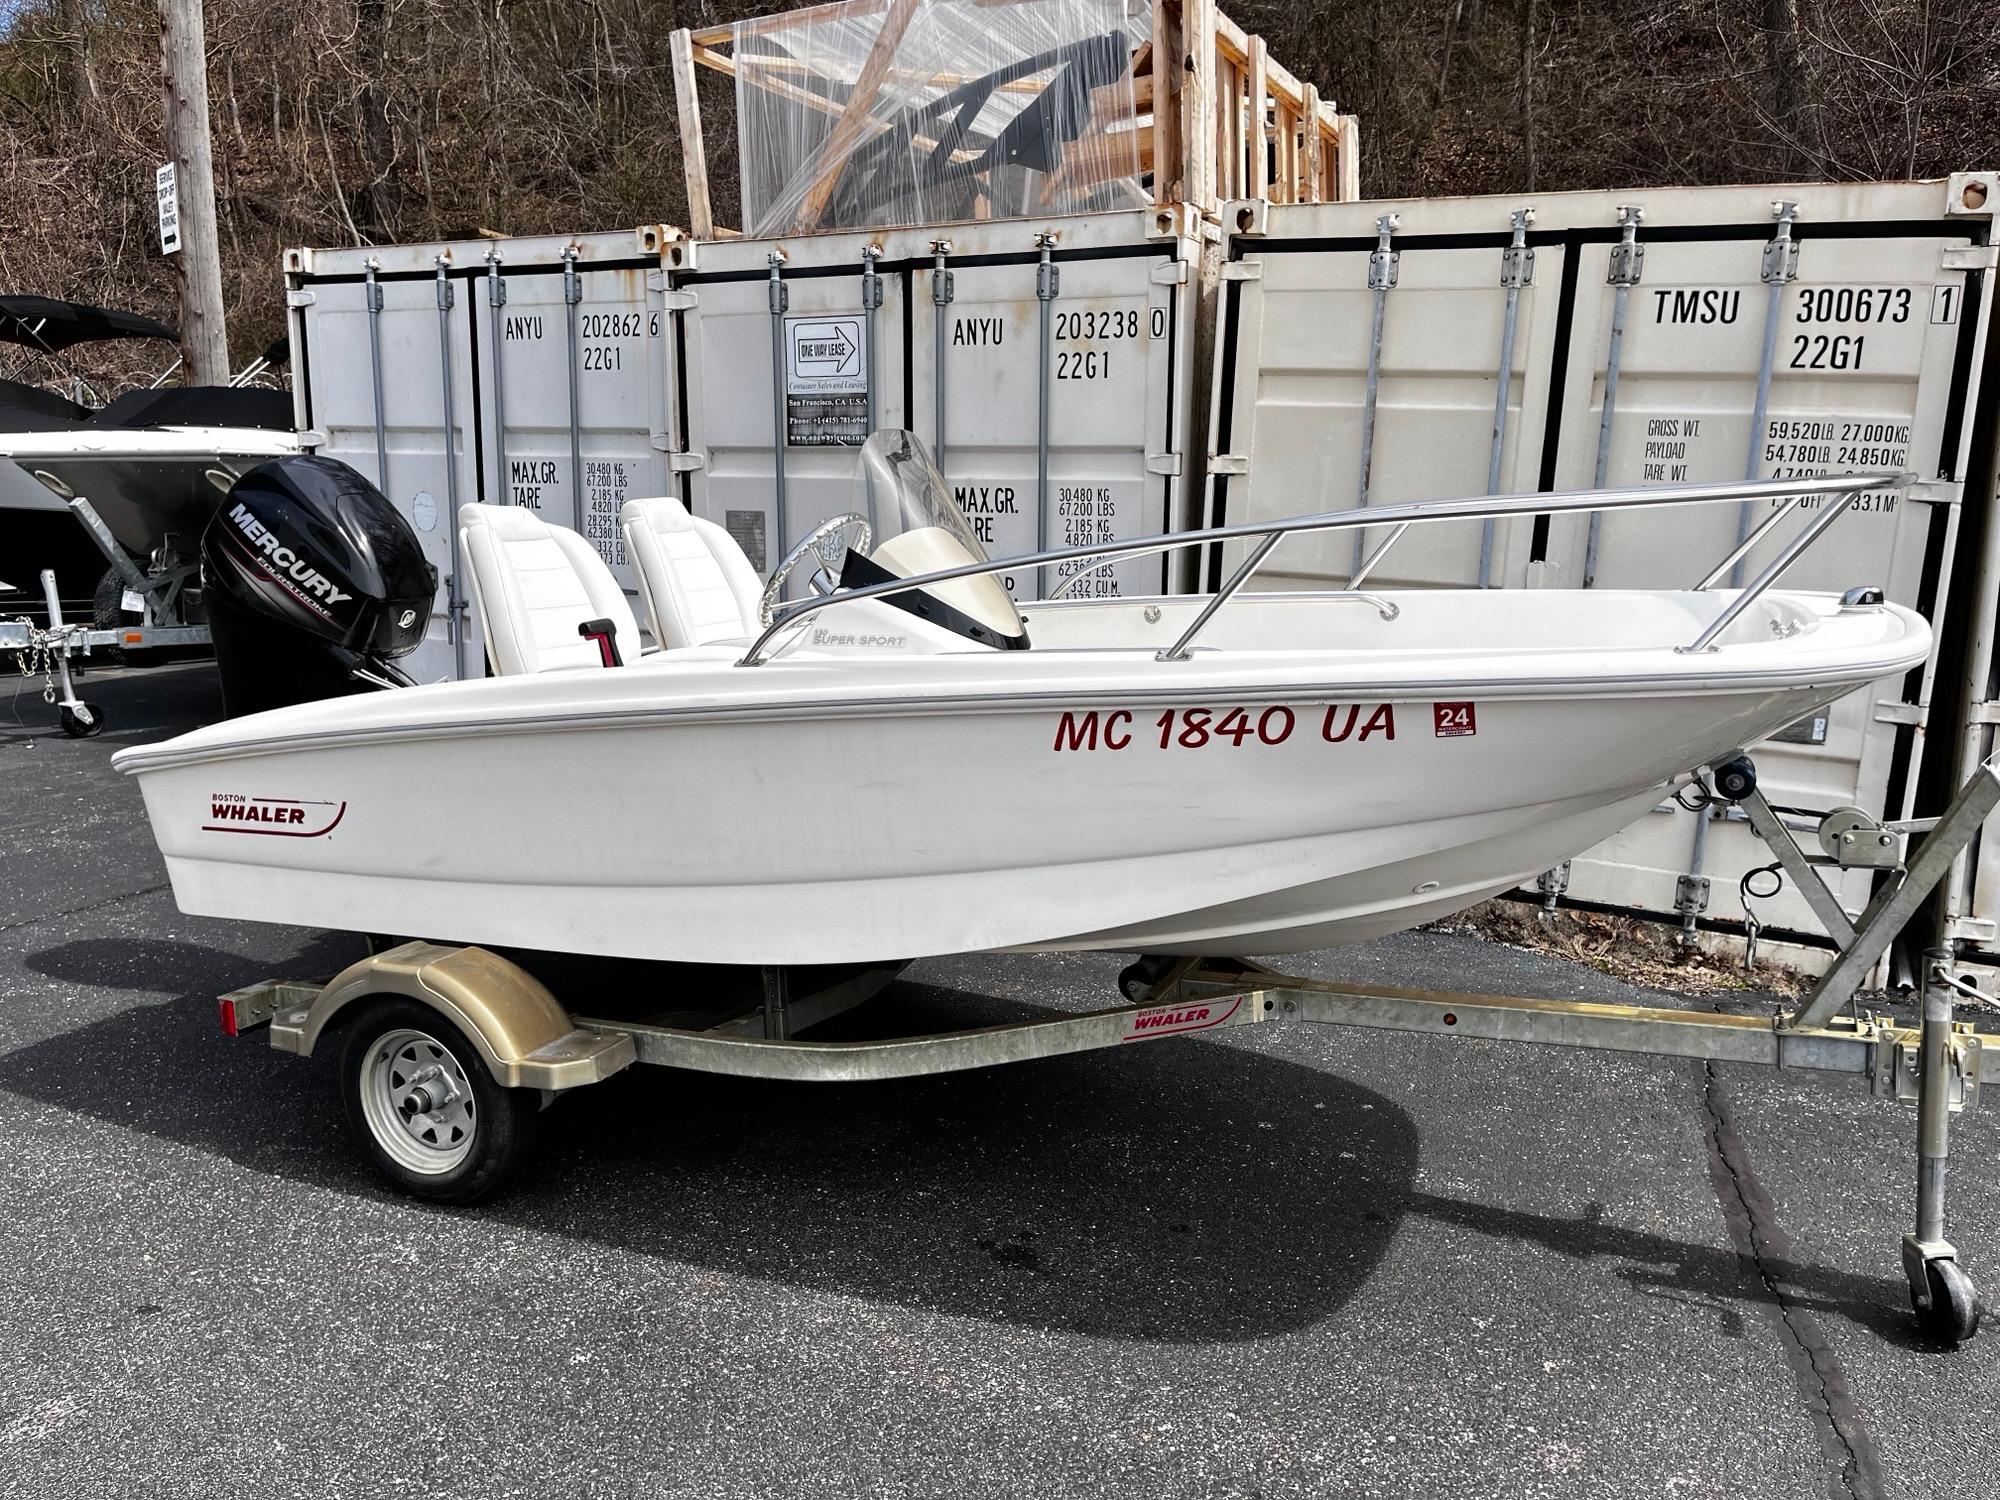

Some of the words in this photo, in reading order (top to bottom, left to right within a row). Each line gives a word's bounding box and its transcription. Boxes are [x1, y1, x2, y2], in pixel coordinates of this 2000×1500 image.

[1654, 290, 1740, 324] TMSU
[1796, 288, 1912, 323] 300673
[1941, 288, 1952, 322] 1
[505, 316, 543, 340] ANYU
[582, 313, 641, 339] 202862
[650, 313, 659, 337] 6
[953, 318, 1003, 345] ANYU
[1056, 311, 1138, 340] 203238
[1152, 309, 1164, 337] 0
[801, 345, 813, 357] ONE
[814, 344, 827, 357] WAY
[828, 343, 846, 356] LEASE
[1790, 335, 1865, 370] 22G1
[584, 347, 621, 371] 22G1
[1057, 351, 1109, 379] 22G1
[818, 382, 832, 390] Sales
[844, 381, 867, 390] Leasing
[802, 399, 834, 407] Francisco,
[835, 398, 846, 406] CA
[1648, 419, 1679, 437] GROSS
[1645, 442, 1686, 459] PAYLOAD
[512, 461, 559, 484] MAX.GR.
[586, 462, 611, 475] 30.480
[614, 463, 624, 475] KG
[1644, 464, 1664, 481] TARE
[614, 475, 628, 487] LBS
[513, 487, 542, 509] TARE
[615, 490, 624, 502] KG
[955, 486, 1019, 514] MAX.GR.
[1059, 488, 1093, 502] 30.480
[1097, 489, 1110, 502] KG
[1059, 503, 1093, 516] 67.200
[1097, 503, 1115, 516] LBS
[1065, 519, 1093, 533] 2.185
[1097, 519, 1110, 533] KG
[1065, 533, 1093, 547] 4.820
[229, 503, 352, 605] MERCURY
[1096, 563, 1114, 578] LBS
[256, 556, 333, 618] FOURSTROKE
[813, 635, 856, 645] SUPER
[859, 636, 906, 646] SPORT
[1440, 708, 1469, 727] 24
[1054, 710, 1133, 752] MC
[1156, 705, 1295, 750] 1840
[1322, 703, 1396, 743] UA
[212, 793, 246, 802] BOSTON
[212, 804, 305, 824] WHALER
[1134, 1008, 1210, 1030] WHALER
[1137, 1008, 1166, 1018] BOSTON
